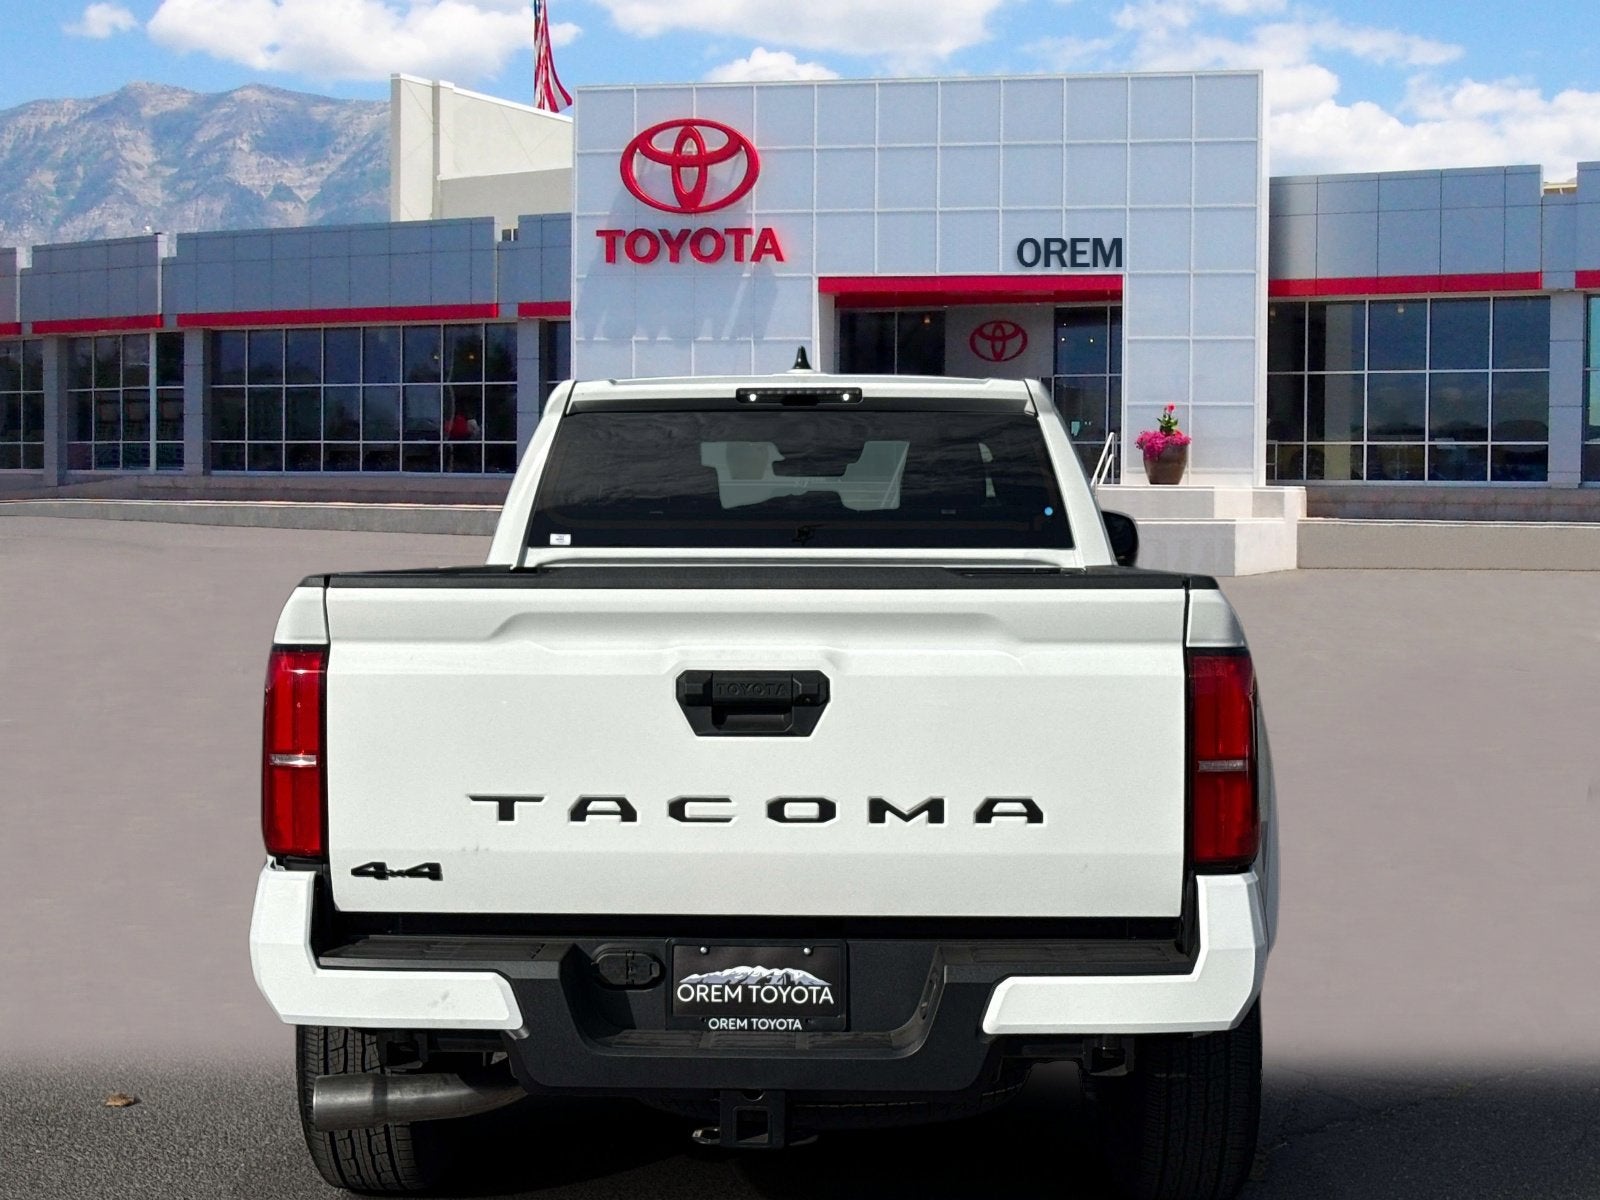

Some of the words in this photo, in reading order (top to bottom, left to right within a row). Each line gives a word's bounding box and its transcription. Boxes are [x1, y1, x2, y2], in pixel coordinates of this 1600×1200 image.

[596, 227, 784, 264] TOYOTA
[1016, 238, 1123, 268] OREM
[716, 682, 787, 697] TOYOTA
[468, 794, 1045, 824] TACOMA
[677, 983, 742, 1003] OREM
[748, 984, 835, 1005] TOYOTA
[708, 1018, 748, 1030] OREM
[751, 1018, 803, 1031] TOYOTA
